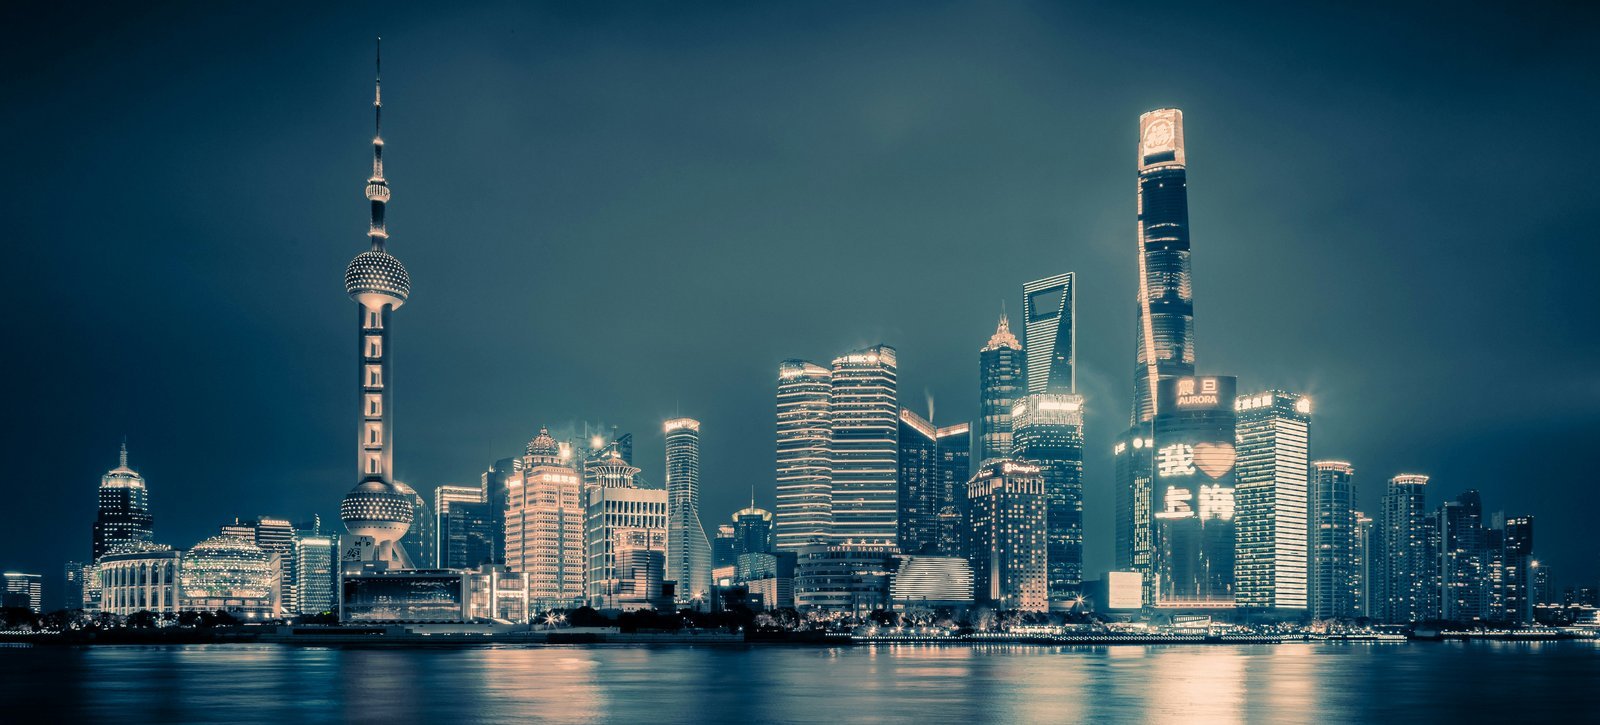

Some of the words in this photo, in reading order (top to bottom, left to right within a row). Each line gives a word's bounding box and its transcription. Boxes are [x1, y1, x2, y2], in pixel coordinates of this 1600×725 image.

[1178, 379, 1217, 395] 震旦
[1178, 395, 1217, 404] AURORA
[1157, 443, 1196, 477] 我
[1154, 483, 1235, 520] 上海
